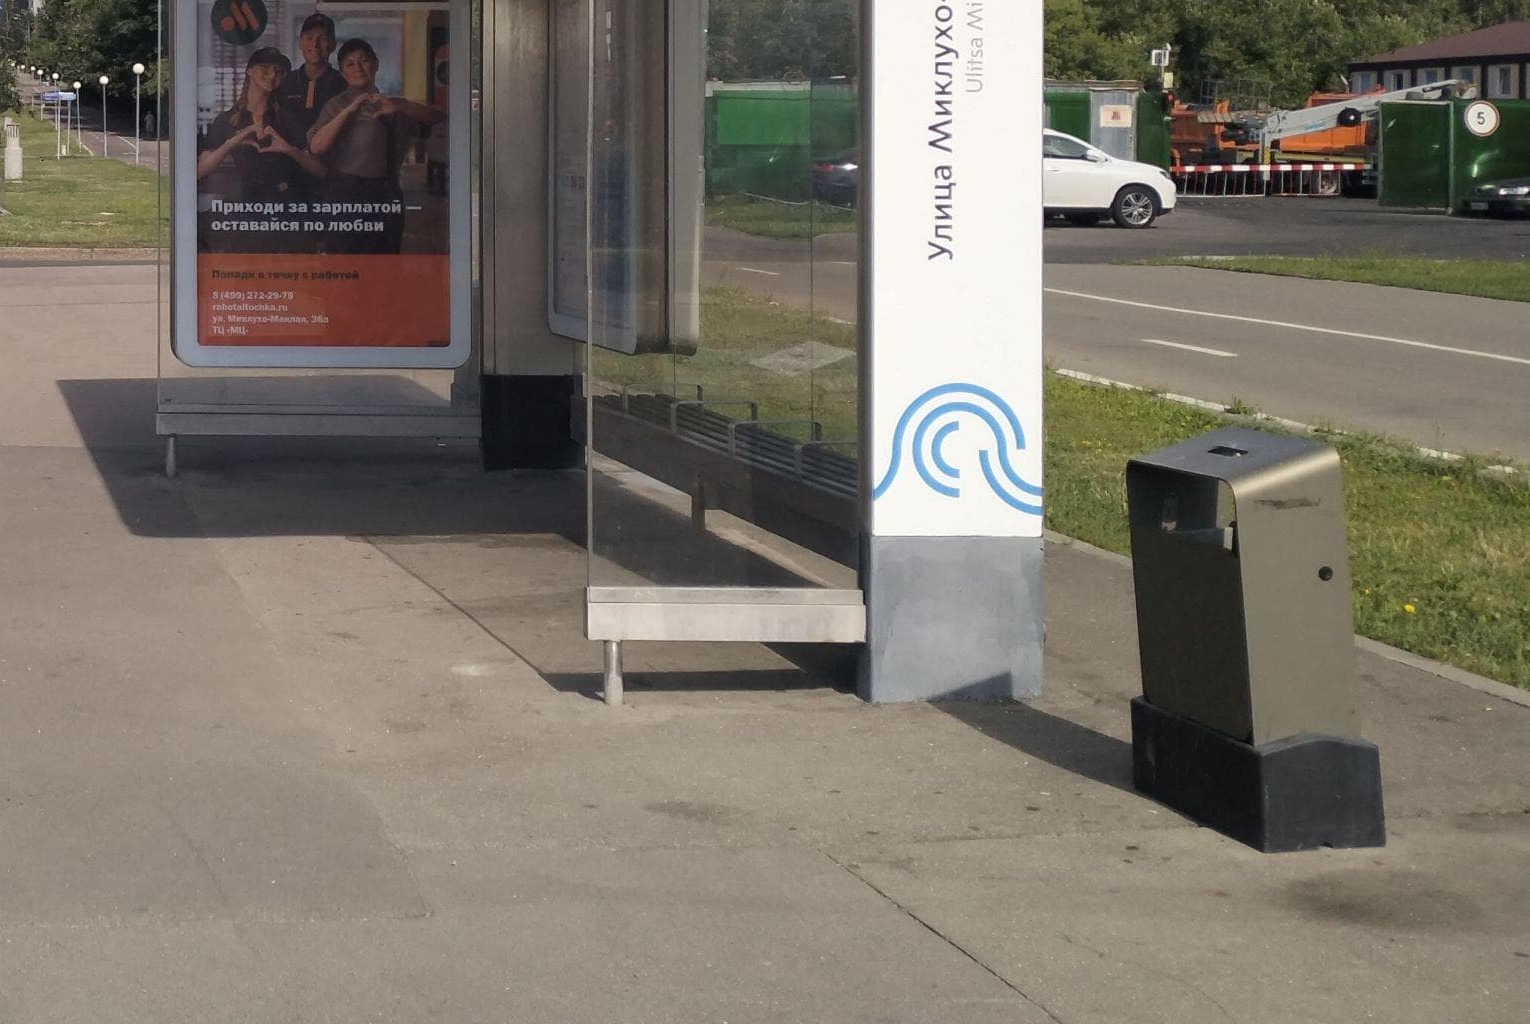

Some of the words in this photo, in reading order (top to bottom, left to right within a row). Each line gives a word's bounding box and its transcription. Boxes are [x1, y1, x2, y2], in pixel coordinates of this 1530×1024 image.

[965, 37, 984, 93] Ulitsa
[1477, 111, 1486, 125] 5
[211, 199, 285, 216] Приходи
[288, 202, 308, 213] за
[312, 199, 402, 216] зарплатой
[927, 165, 957, 261] Улица
[211, 217, 300, 232] оставайся
[303, 221, 324, 232] по
[327, 219, 384, 232] любви
[302, 271, 310, 279] с
